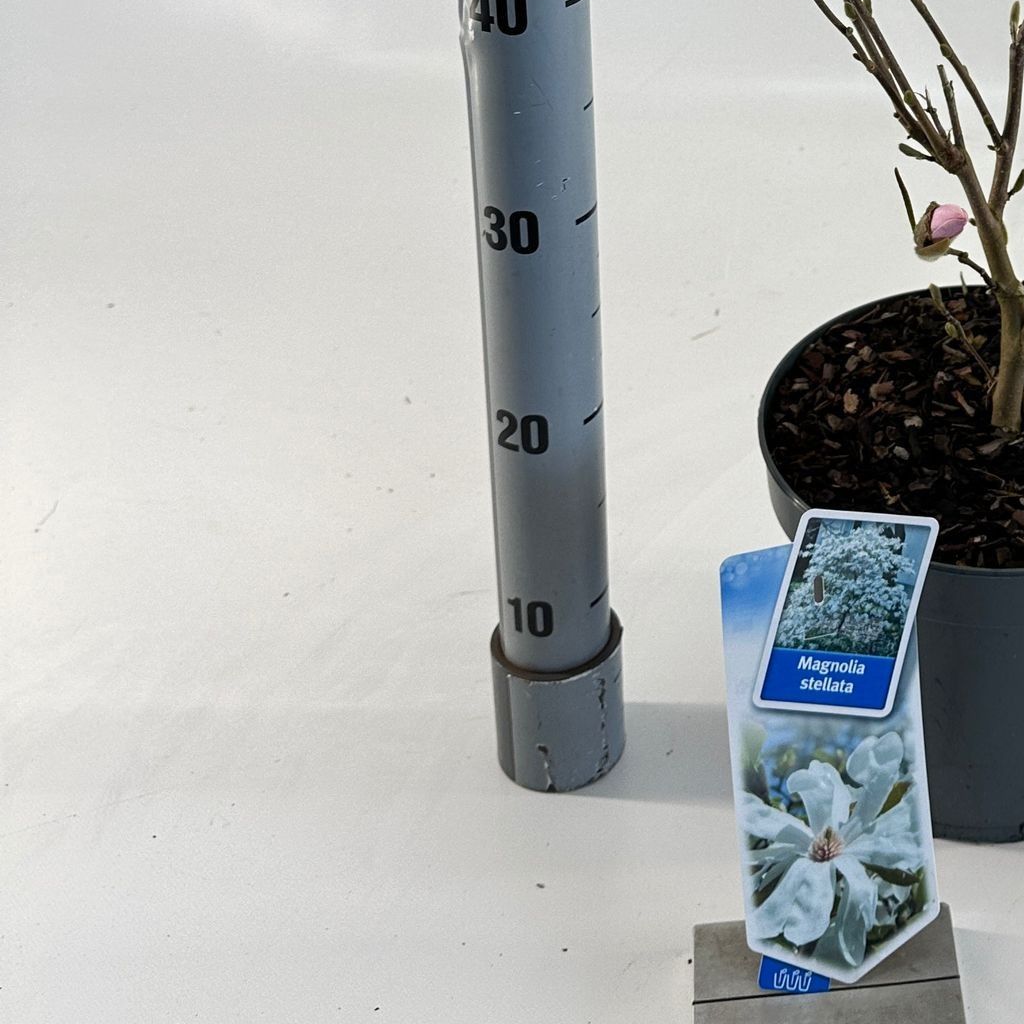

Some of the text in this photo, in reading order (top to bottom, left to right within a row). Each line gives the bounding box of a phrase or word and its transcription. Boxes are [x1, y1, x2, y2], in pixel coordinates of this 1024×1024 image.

[484, 205, 539, 255] 30
[496, 409, 549, 455] 20
[507, 597, 554, 638] 10
[797, 655, 866, 675] Magnolia
[799, 676, 854, 694] stellata
